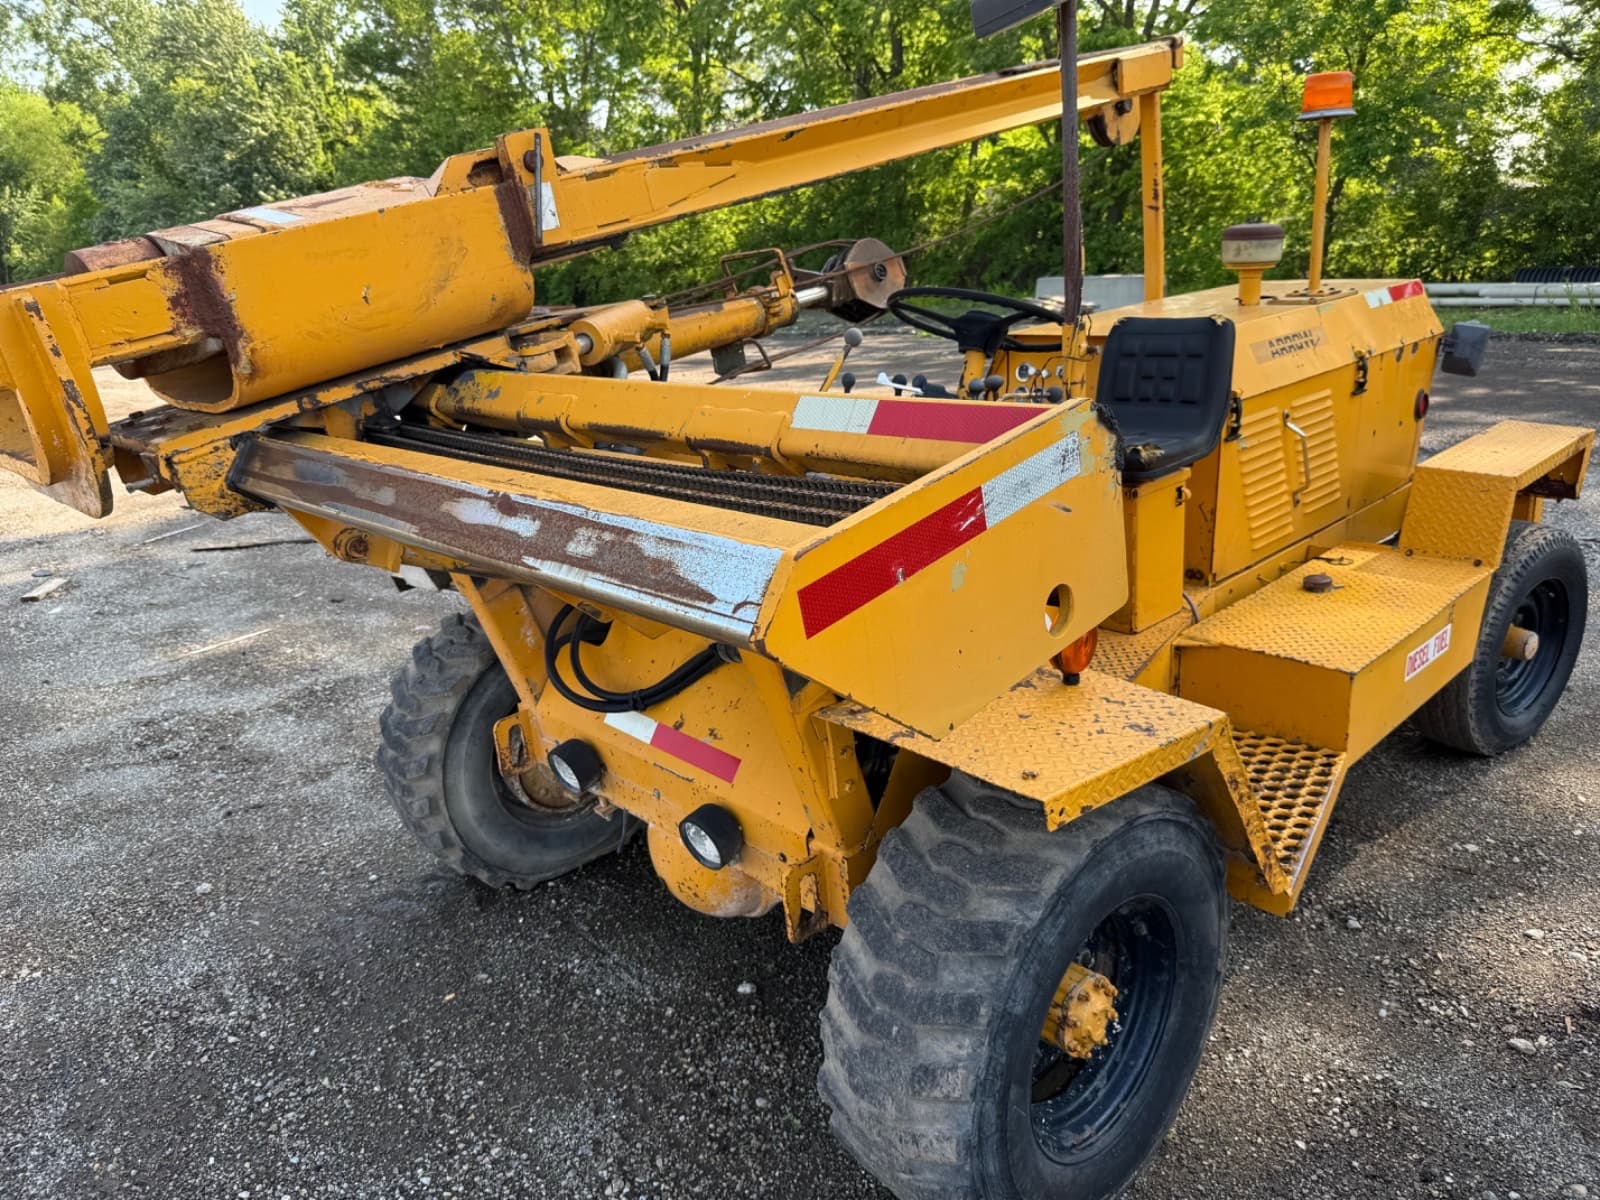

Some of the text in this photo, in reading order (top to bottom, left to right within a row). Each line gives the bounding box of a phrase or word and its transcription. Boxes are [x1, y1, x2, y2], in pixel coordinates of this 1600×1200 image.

[1268, 329, 1314, 358] ARROW
[1406, 628, 1448, 677] DIESEL FUEL
